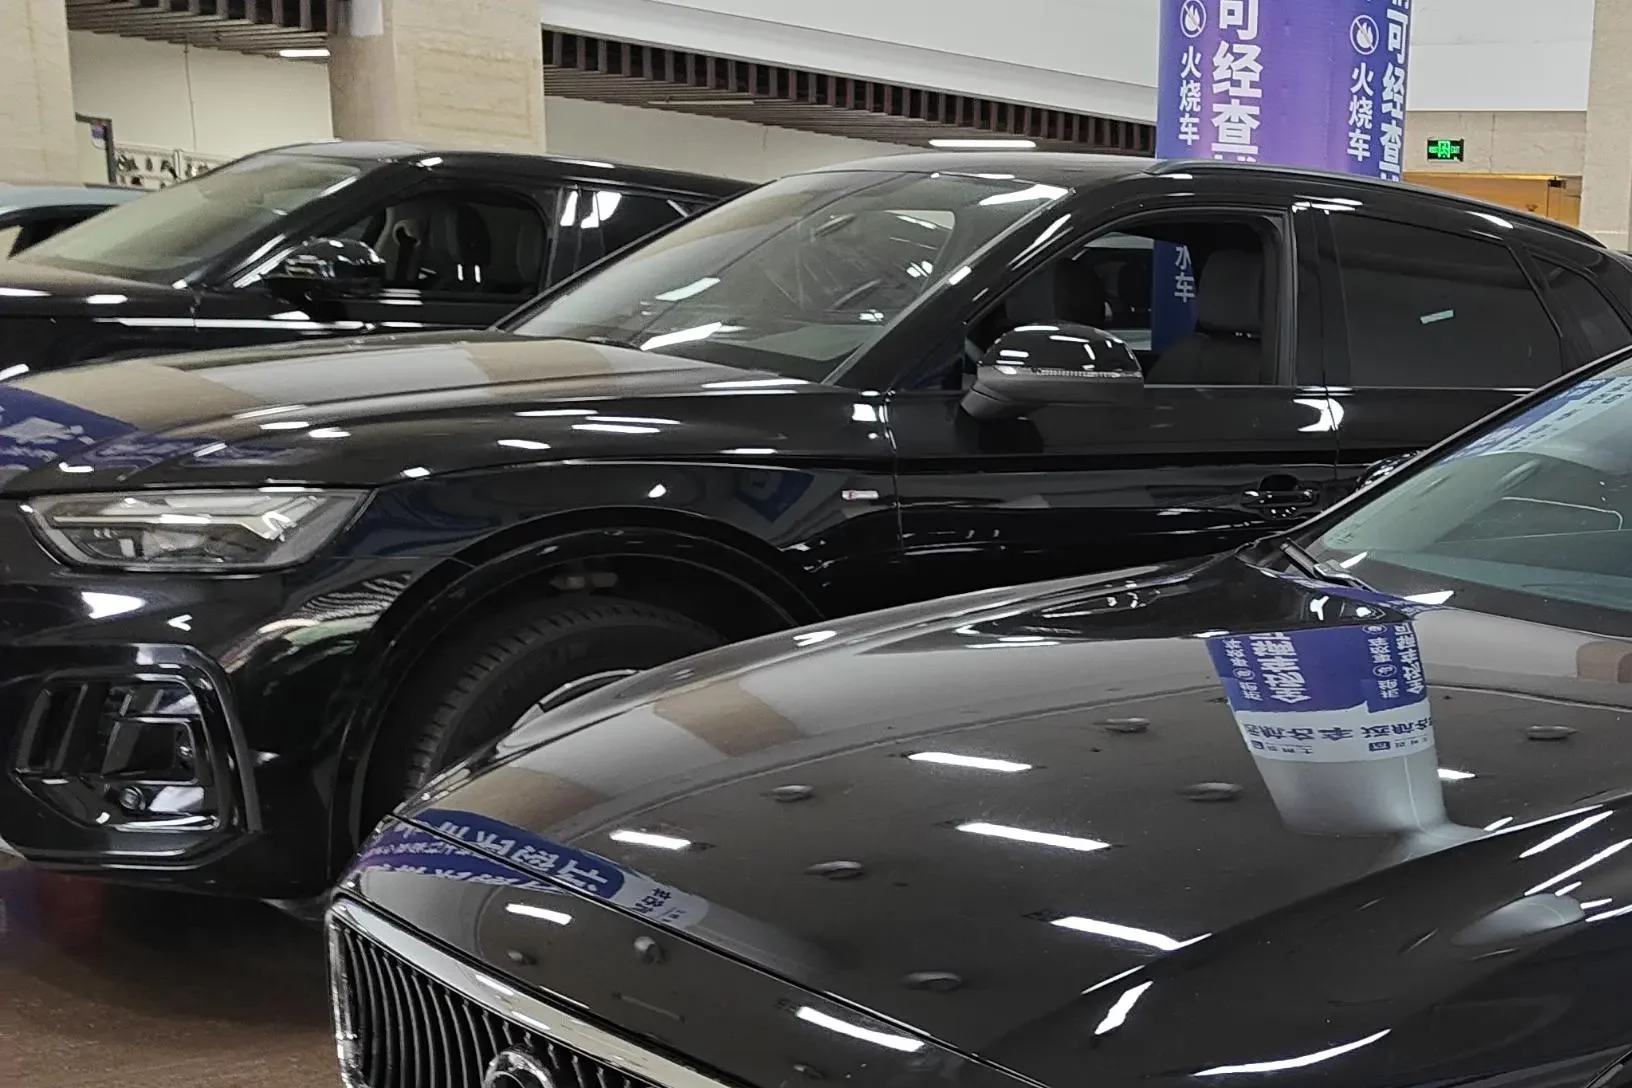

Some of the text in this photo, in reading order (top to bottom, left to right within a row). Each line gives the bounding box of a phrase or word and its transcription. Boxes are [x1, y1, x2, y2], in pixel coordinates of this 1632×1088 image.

[1178, 45, 1202, 146] 火烧车
[1347, 62, 1374, 162] 火烧车
